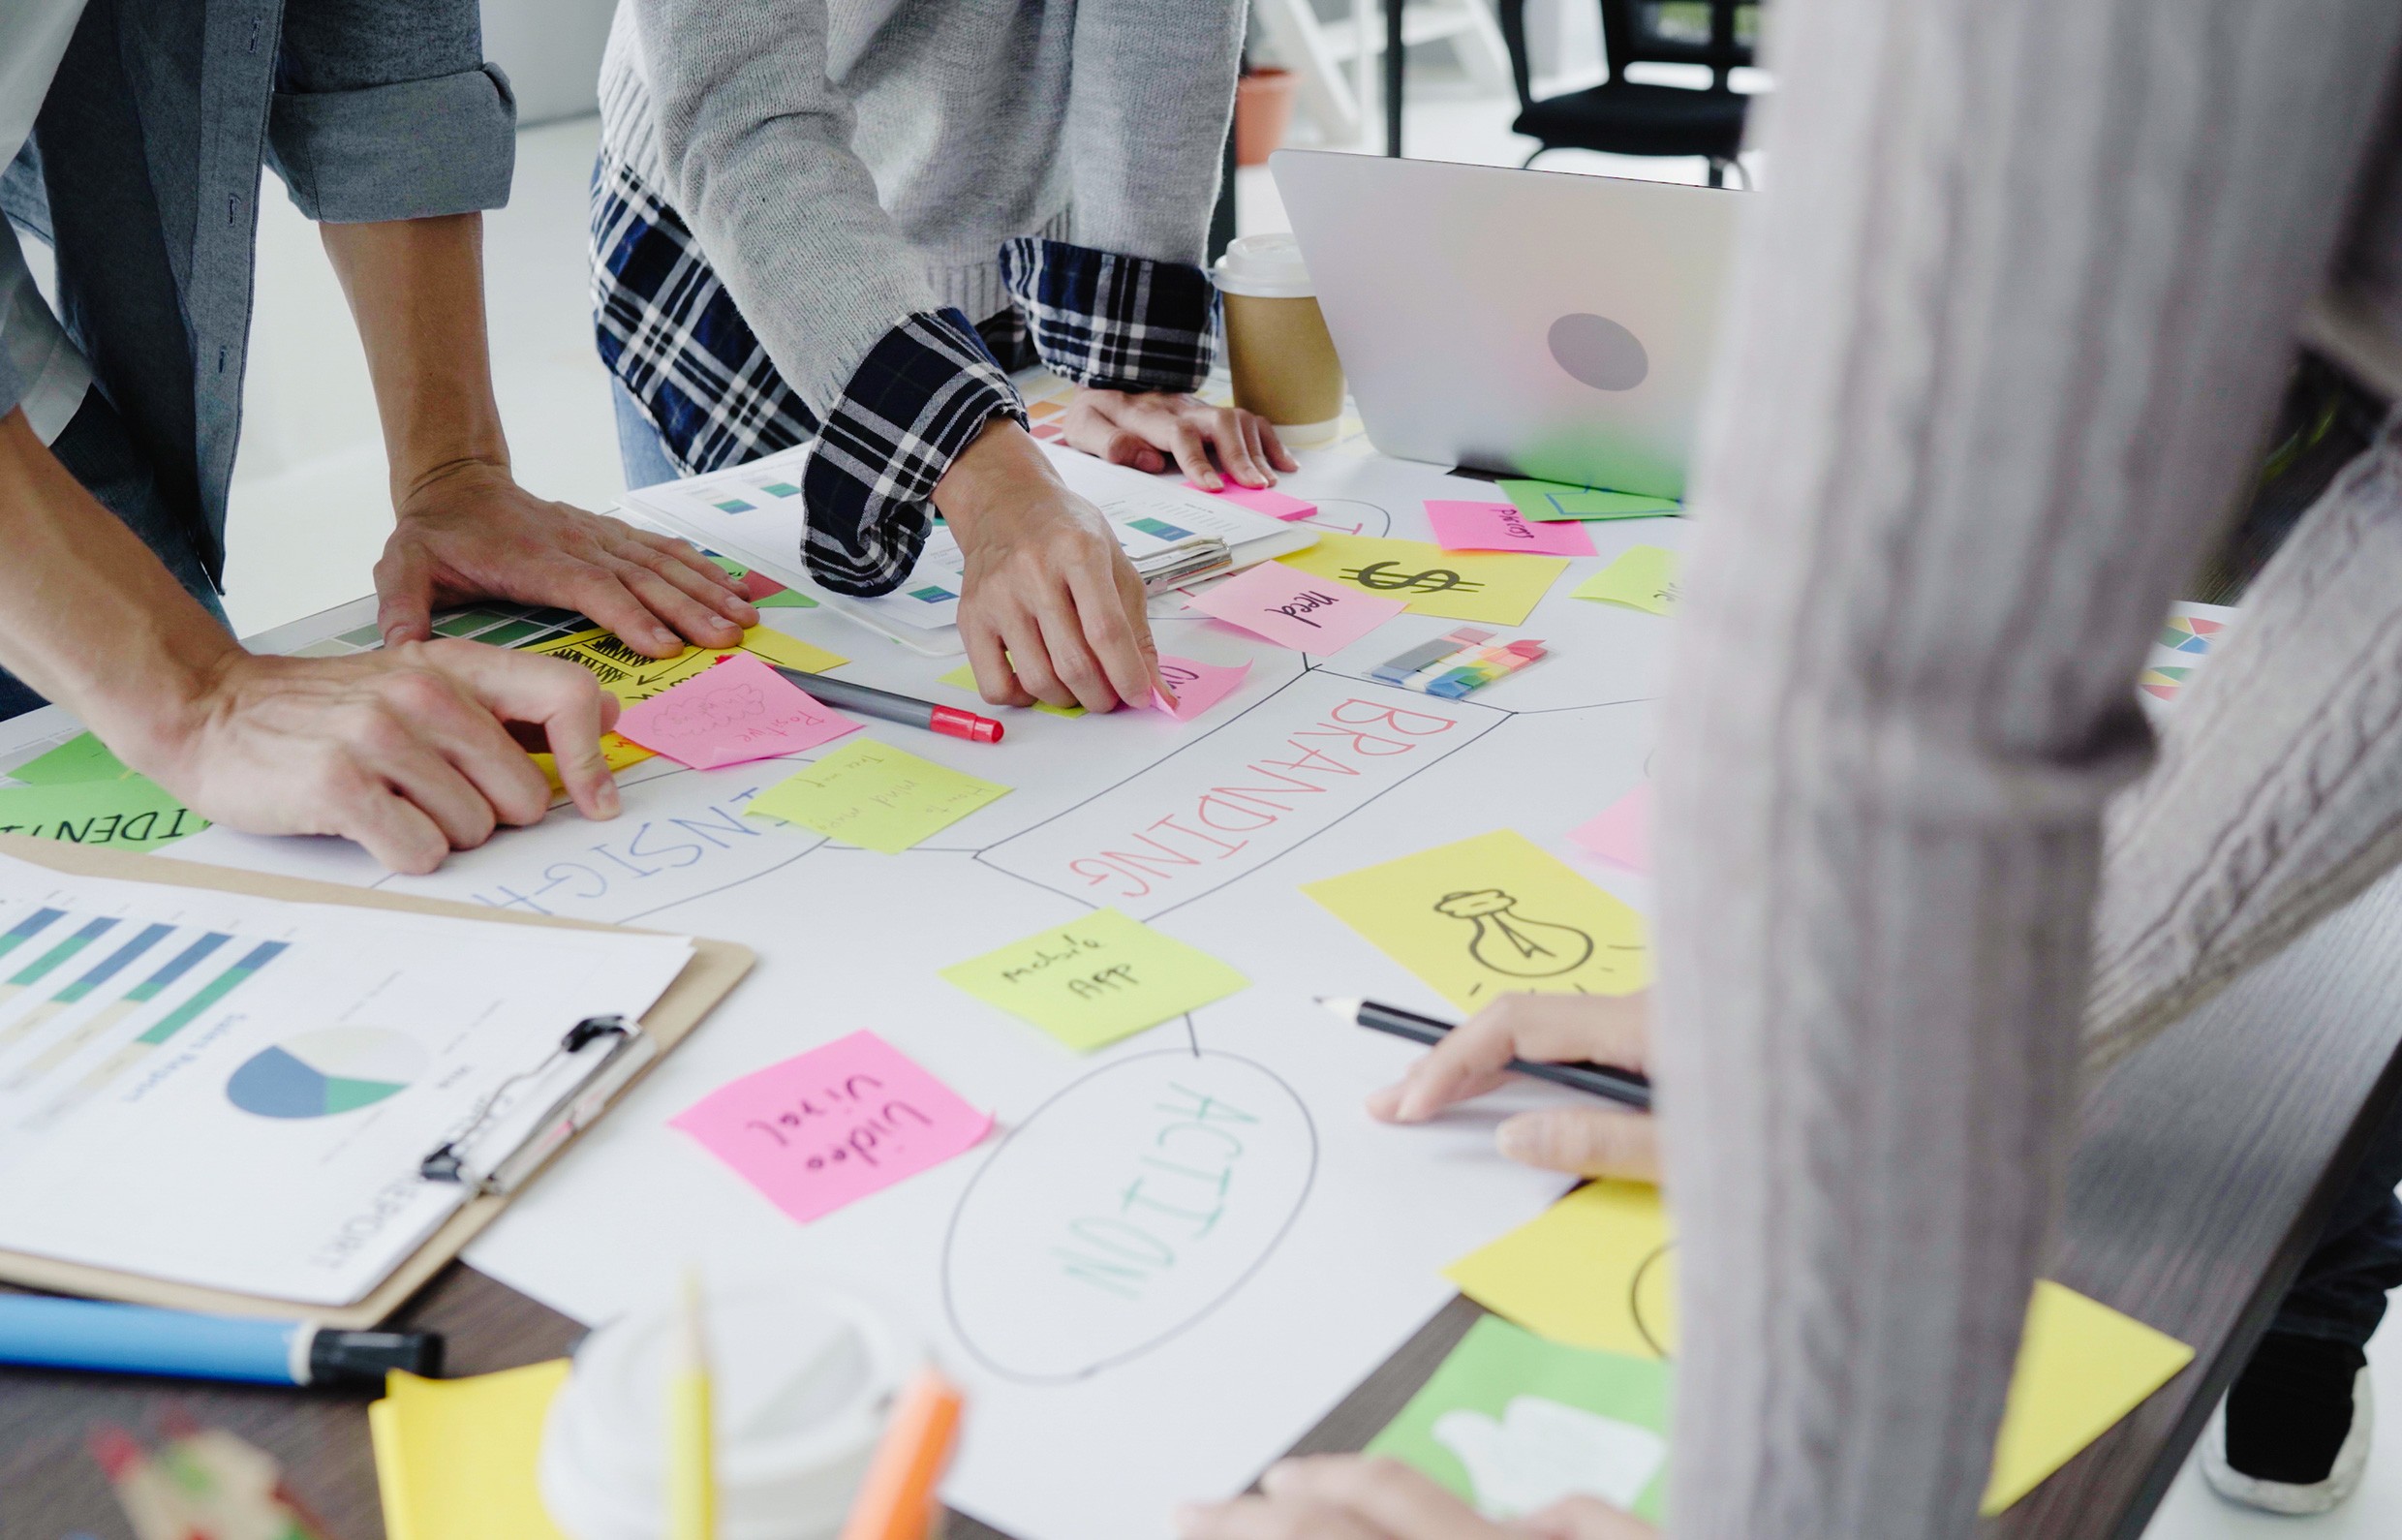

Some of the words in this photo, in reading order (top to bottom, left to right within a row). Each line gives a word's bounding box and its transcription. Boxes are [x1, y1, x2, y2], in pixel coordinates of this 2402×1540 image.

[1339, 560, 1486, 595] $
[1069, 698, 1457, 897] BRANDING
[1048, 1081, 1260, 1300] ACTION
